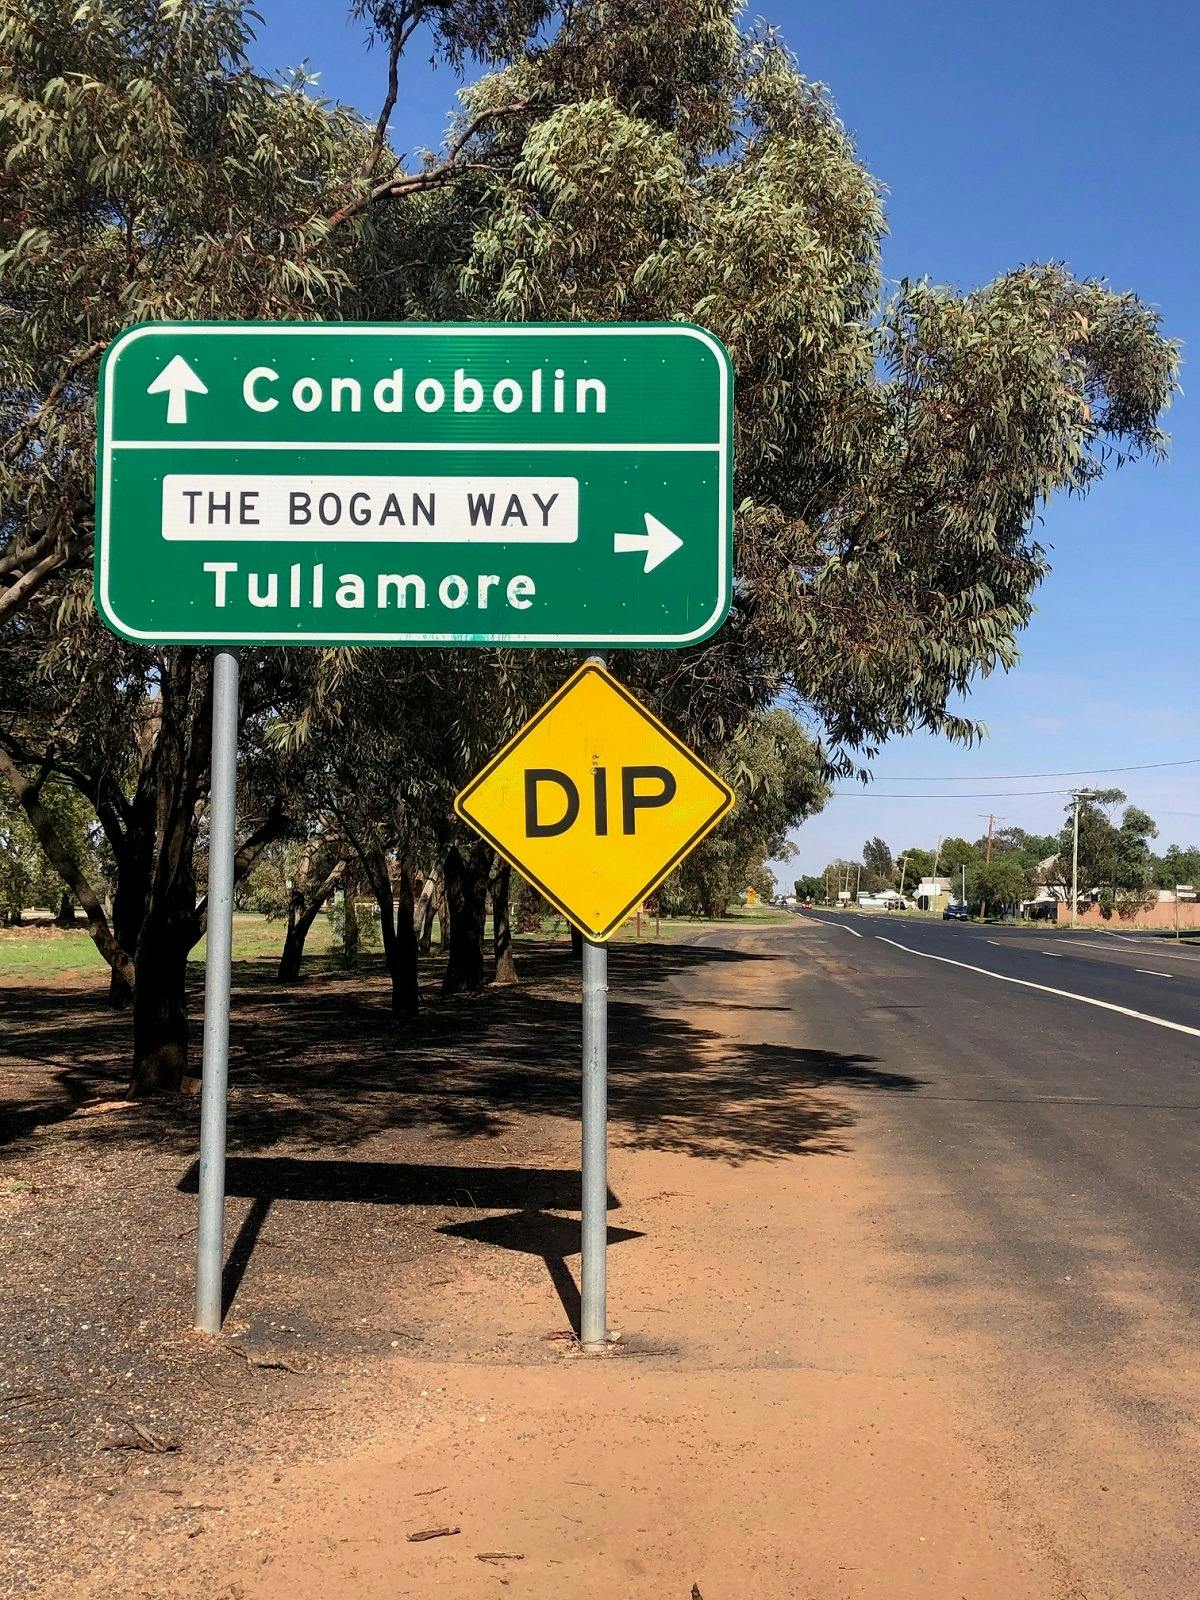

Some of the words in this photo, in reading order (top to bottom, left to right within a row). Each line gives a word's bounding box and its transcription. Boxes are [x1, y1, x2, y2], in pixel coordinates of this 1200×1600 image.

[242, 366, 608, 414] Condobolin
[182, 491, 261, 525] THE
[289, 491, 436, 527] BOGAN
[466, 493, 559, 528] WAY
[203, 561, 536, 610] Tullamore
[524, 765, 677, 838] DIP
